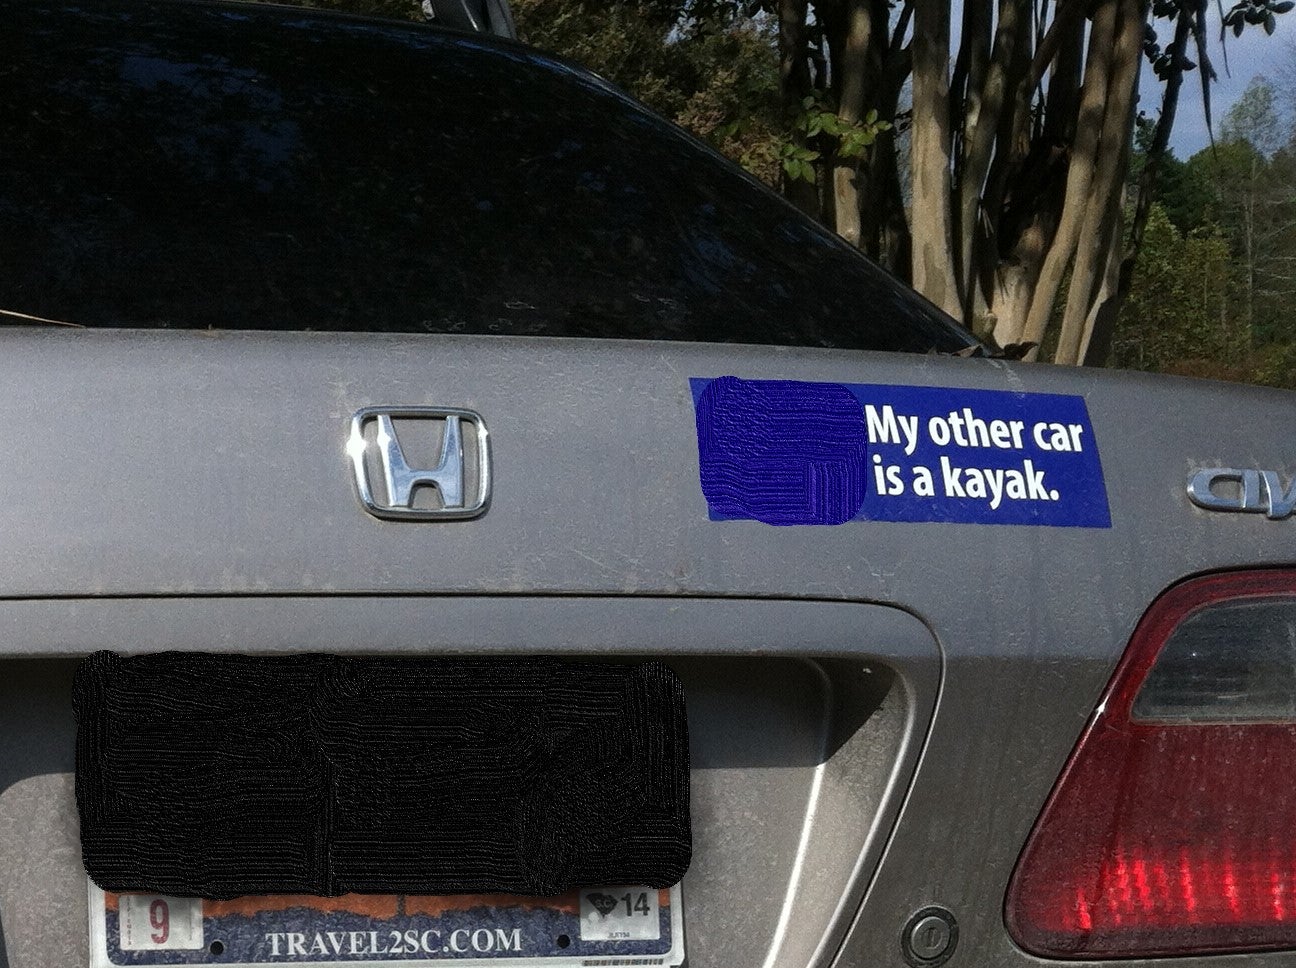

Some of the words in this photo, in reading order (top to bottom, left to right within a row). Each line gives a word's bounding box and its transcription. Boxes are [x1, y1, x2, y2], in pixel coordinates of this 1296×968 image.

[864, 404, 920, 455] My
[927, 408, 1024, 451] other
[1033, 422, 1083, 453] car
[874, 453, 905, 496] is
[914, 466, 935, 497] a
[944, 455, 1060, 509] kayak.
[150, 899, 169, 944] 9
[621, 892, 650, 917] 14
[266, 929, 523, 957] TRAVEL2SC.COM
